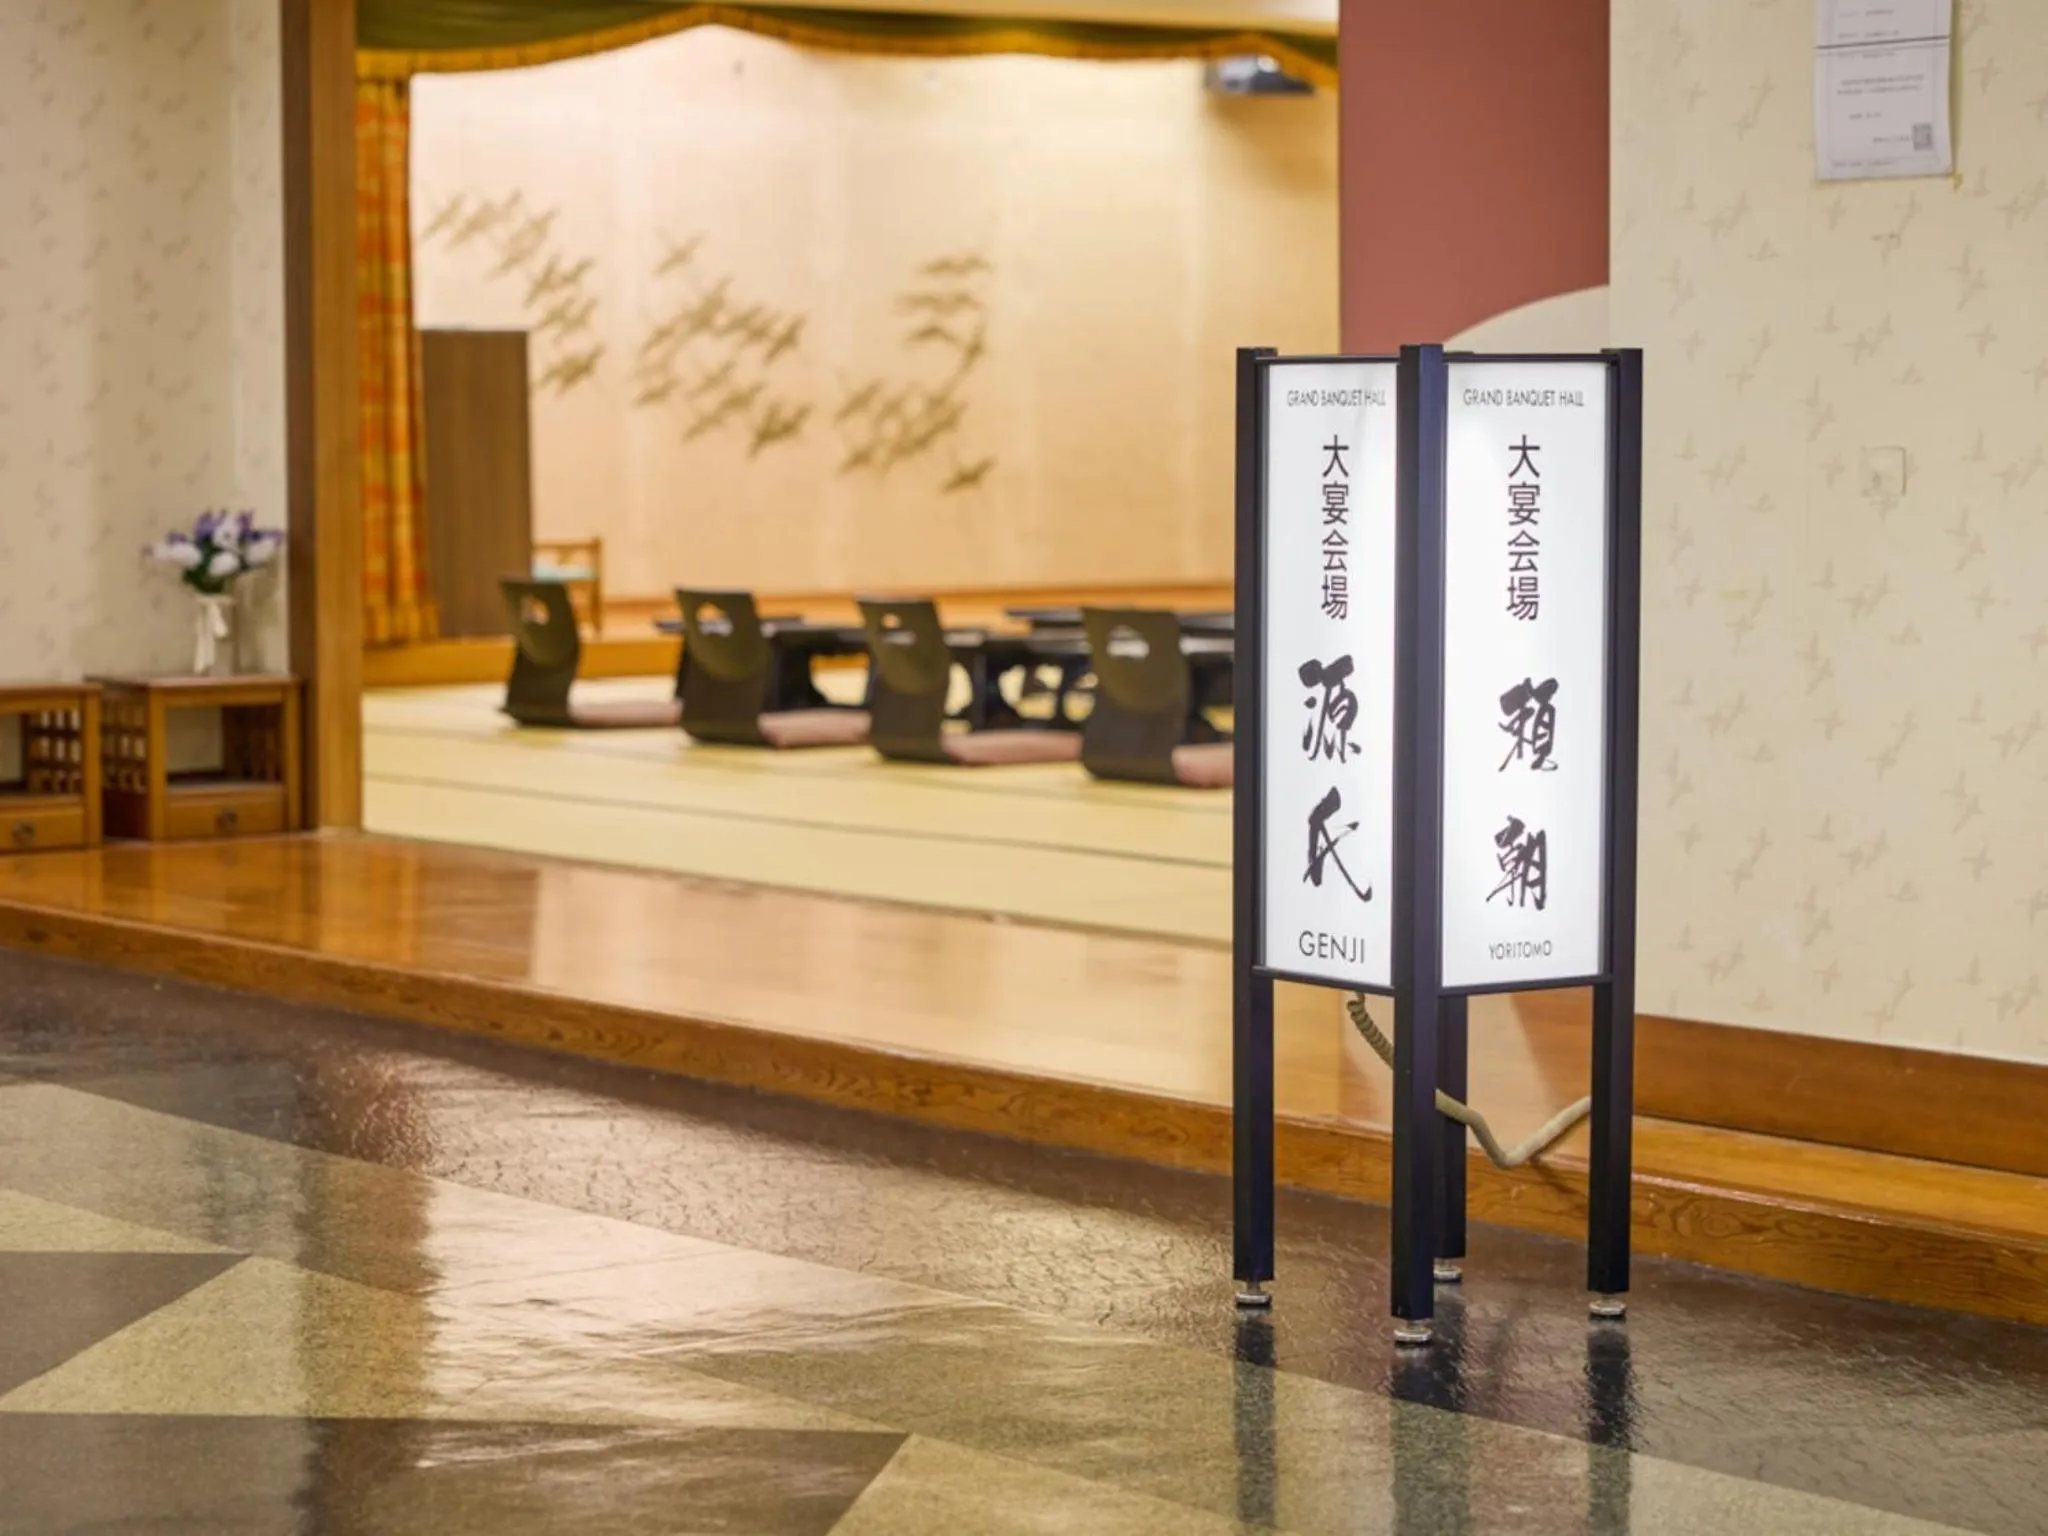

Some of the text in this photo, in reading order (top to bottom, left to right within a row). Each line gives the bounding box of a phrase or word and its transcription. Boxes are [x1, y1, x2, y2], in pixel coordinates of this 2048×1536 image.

[1287, 388, 1386, 407] GRAND BANQUET HALL
[1462, 387, 1585, 407] GRAND BANQUET HALL
[1321, 433, 1350, 621] 大宴会場
[1506, 433, 1541, 622] 大宴会場
[1297, 653, 1373, 904] 源氏
[1298, 929, 1365, 964] GENJI
[1488, 939, 1553, 961] YORITOMO
